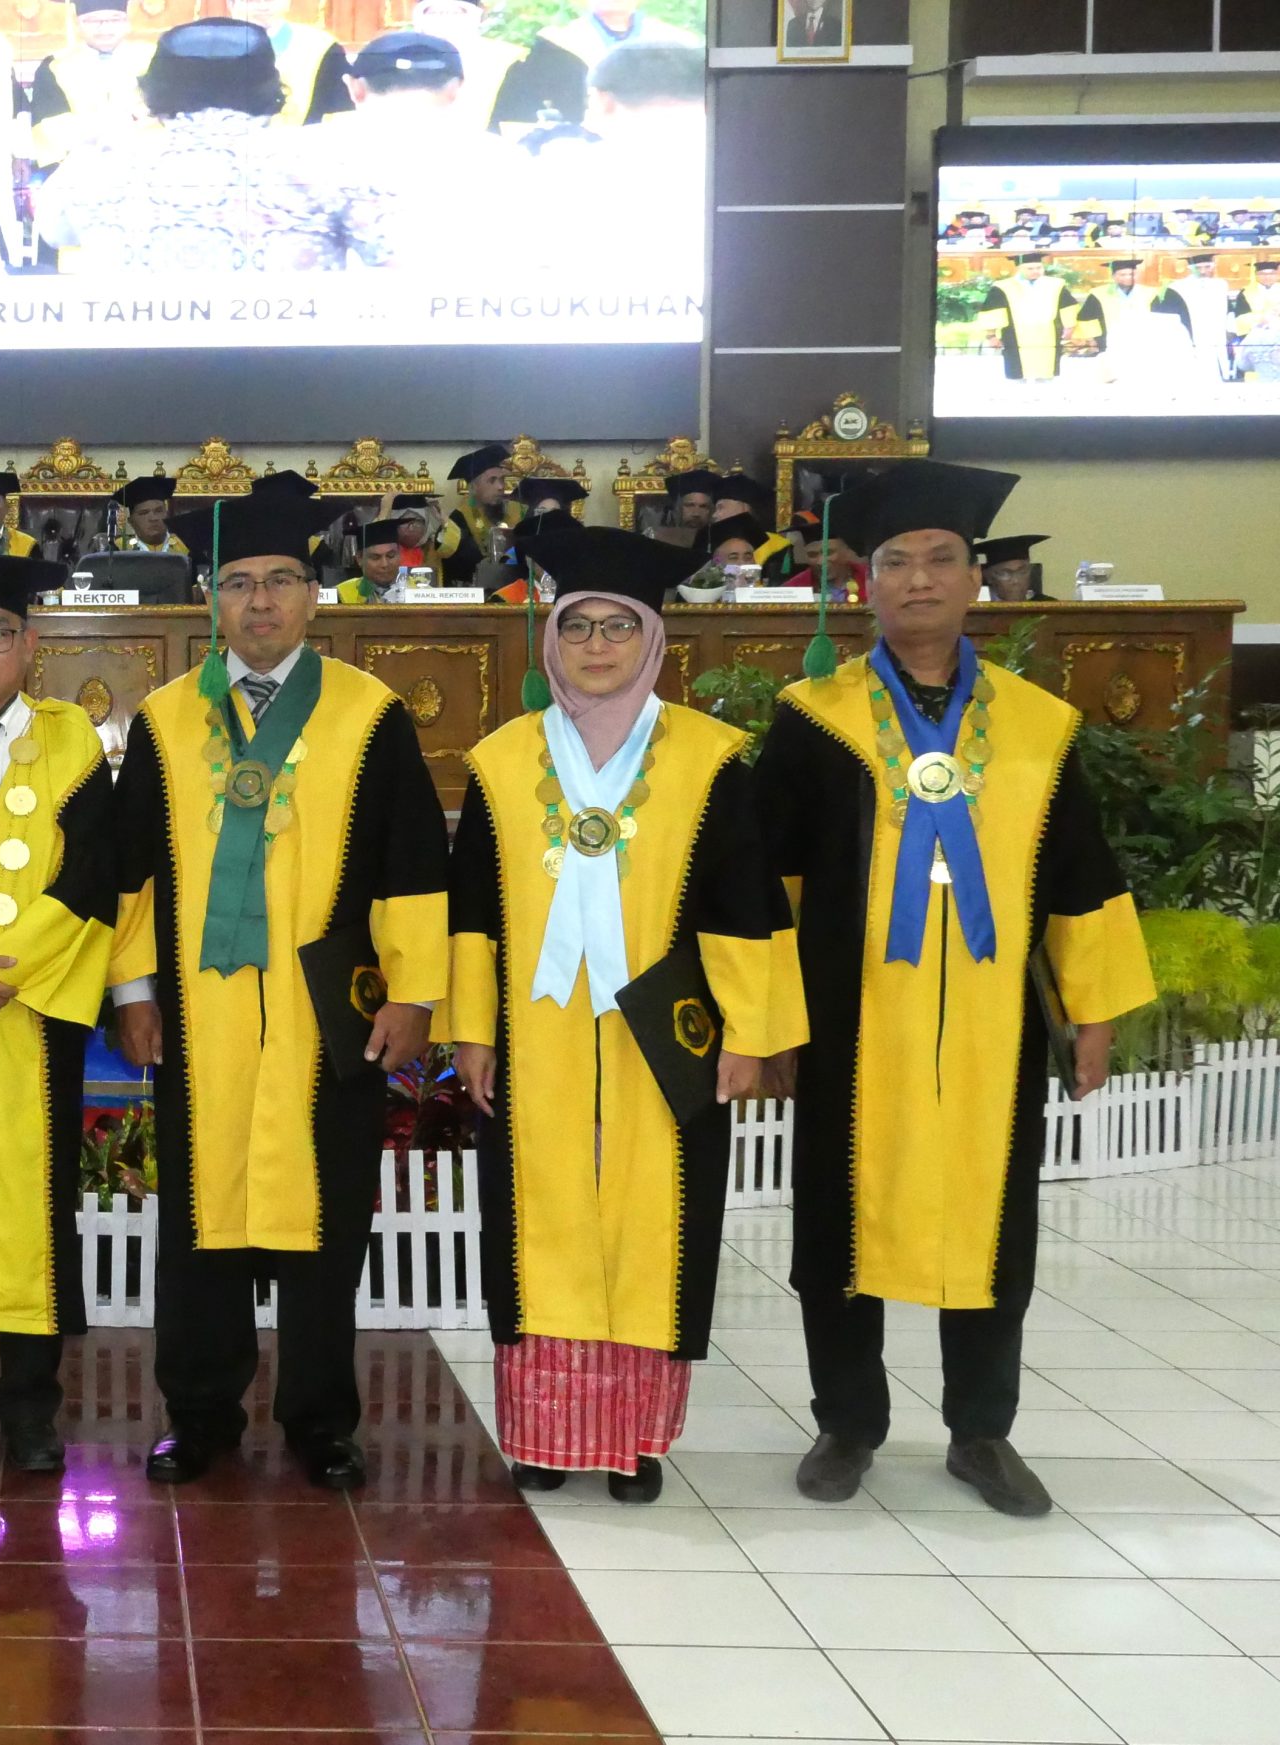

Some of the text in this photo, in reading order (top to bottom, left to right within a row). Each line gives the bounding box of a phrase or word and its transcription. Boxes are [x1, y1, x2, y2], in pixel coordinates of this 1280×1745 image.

[81, 300, 211, 323] TAHUN
[228, 298, 318, 321] 2024
[428, 295, 705, 318] PENGUKUHAN
[73, 593, 126, 604] REKTOR
